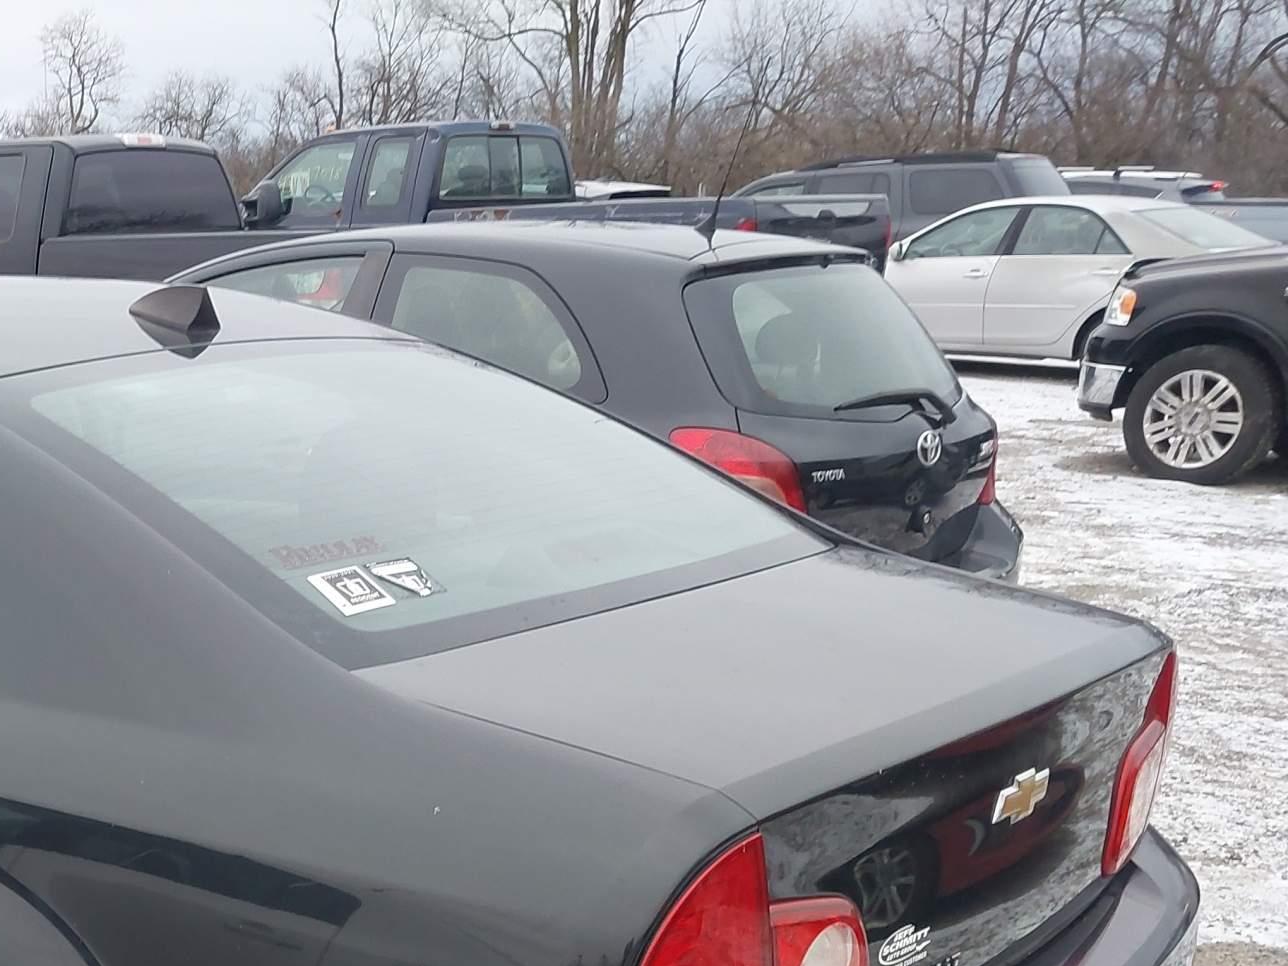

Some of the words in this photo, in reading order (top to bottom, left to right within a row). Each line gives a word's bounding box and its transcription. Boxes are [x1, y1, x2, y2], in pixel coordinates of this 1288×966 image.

[811, 468, 846, 482] TOYOTA
[882, 926, 930, 956] SCHMITT
[894, 925, 915, 941] JEFF
